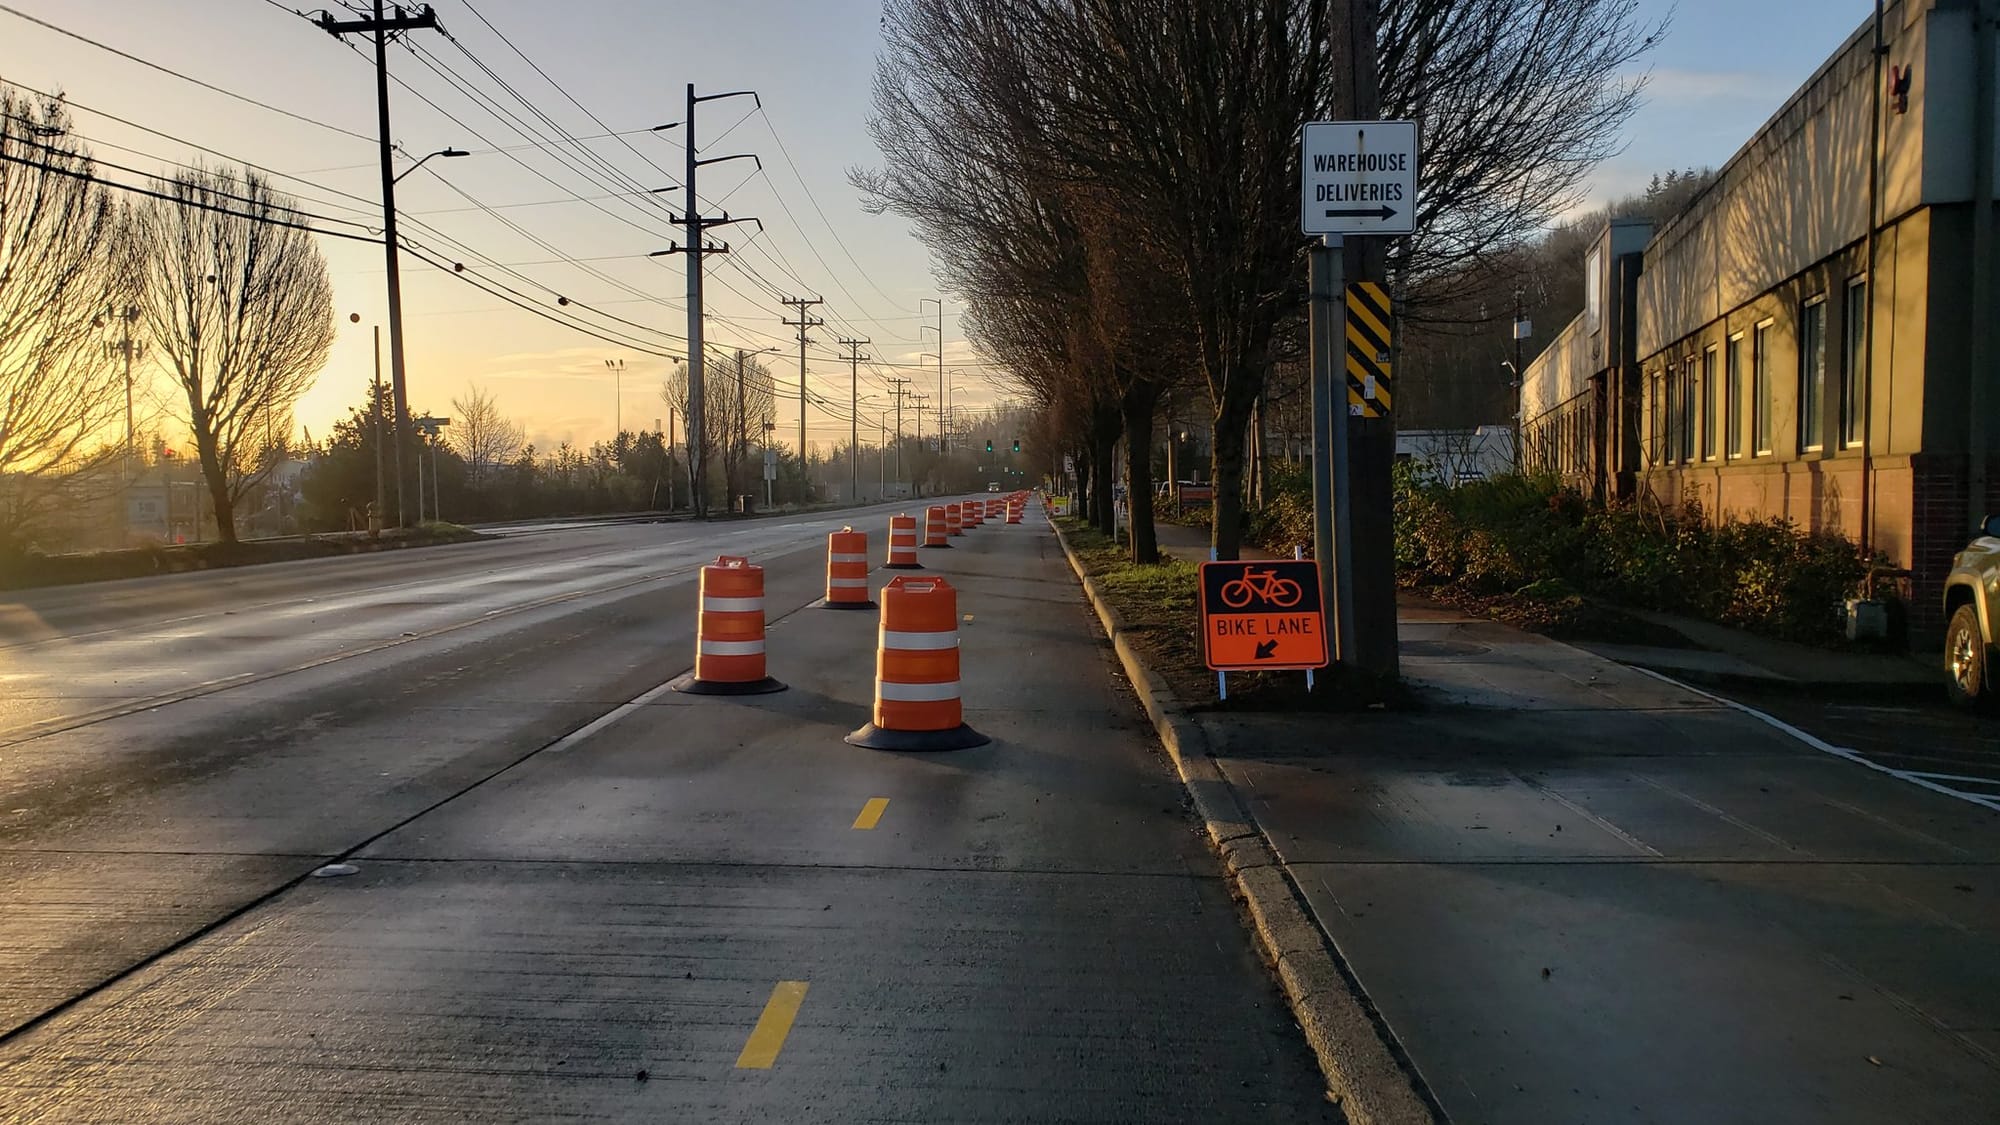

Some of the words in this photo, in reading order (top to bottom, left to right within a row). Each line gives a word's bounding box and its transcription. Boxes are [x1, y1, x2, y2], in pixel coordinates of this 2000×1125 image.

[1313, 153, 1406, 172] WAREHOUSE
[1316, 183, 1402, 202] DELIVERIES
[1217, 619, 1256, 635] BIKE
[1265, 618, 1312, 634] LANE
